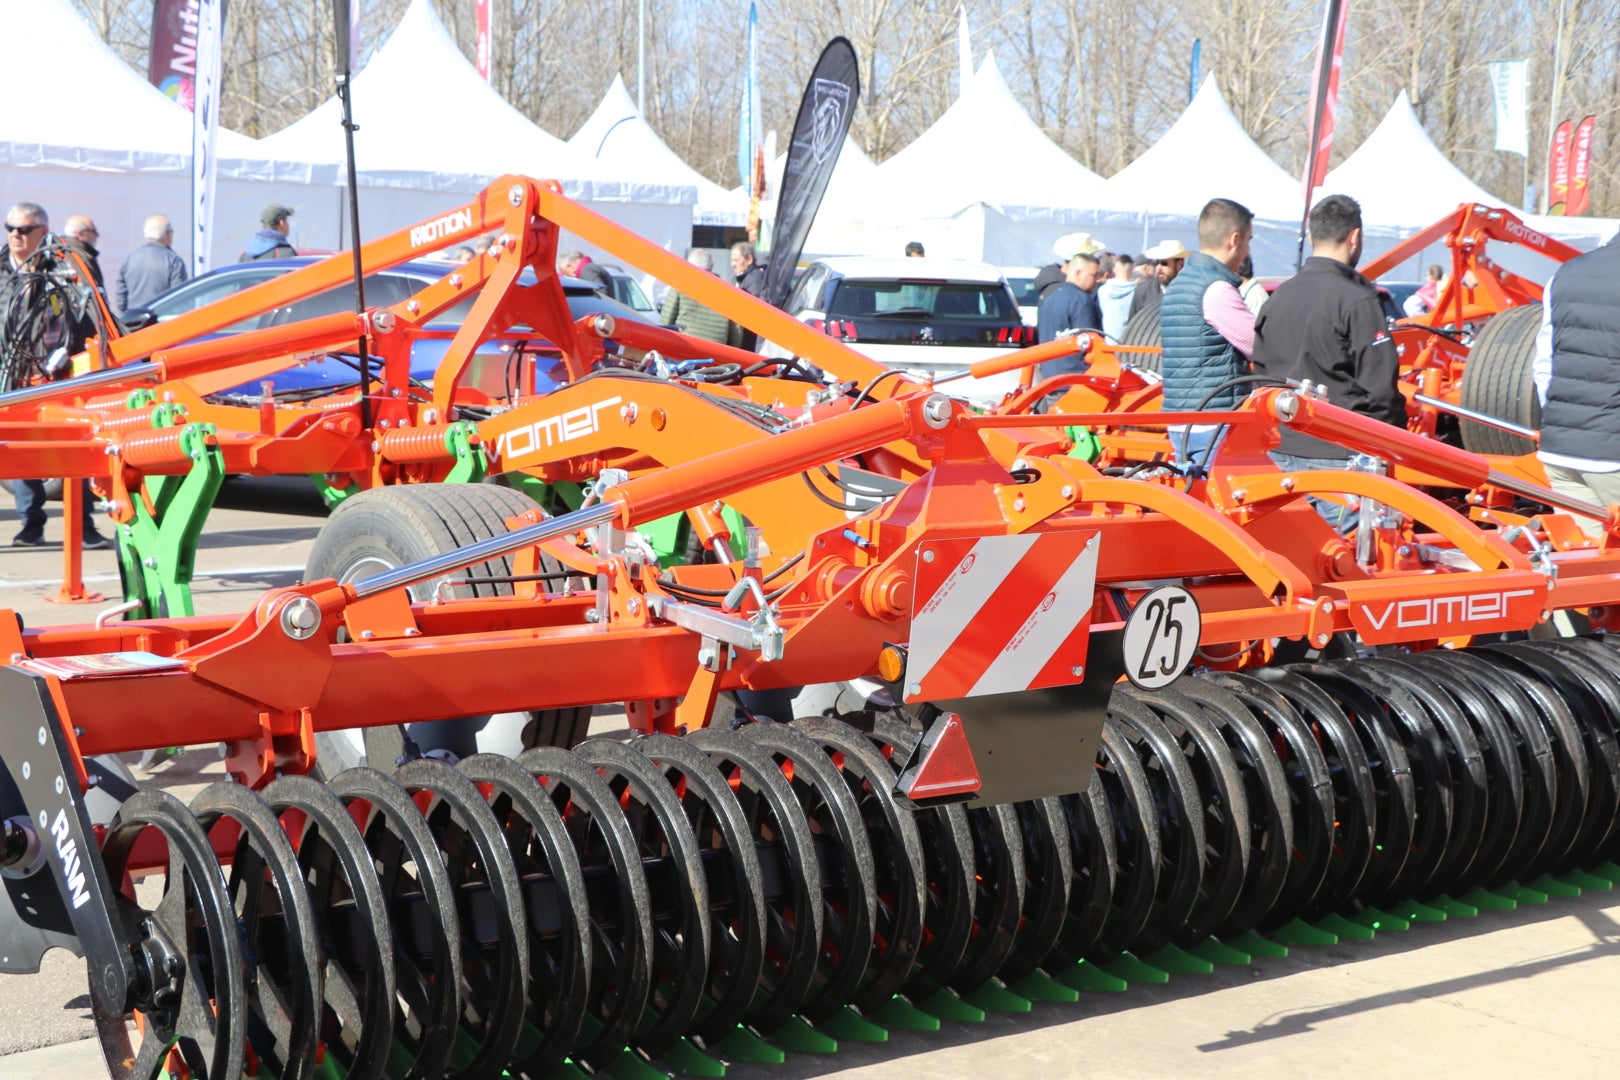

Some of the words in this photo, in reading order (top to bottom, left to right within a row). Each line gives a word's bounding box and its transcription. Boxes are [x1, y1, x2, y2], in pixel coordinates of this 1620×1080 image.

[410, 207, 473, 248] MOTION
[1504, 219, 1547, 249] MOTION
[480, 396, 622, 462] vomer
[1361, 588, 1536, 631] vomer
[1138, 595, 1187, 680] 25
[50, 807, 91, 910] RAW
